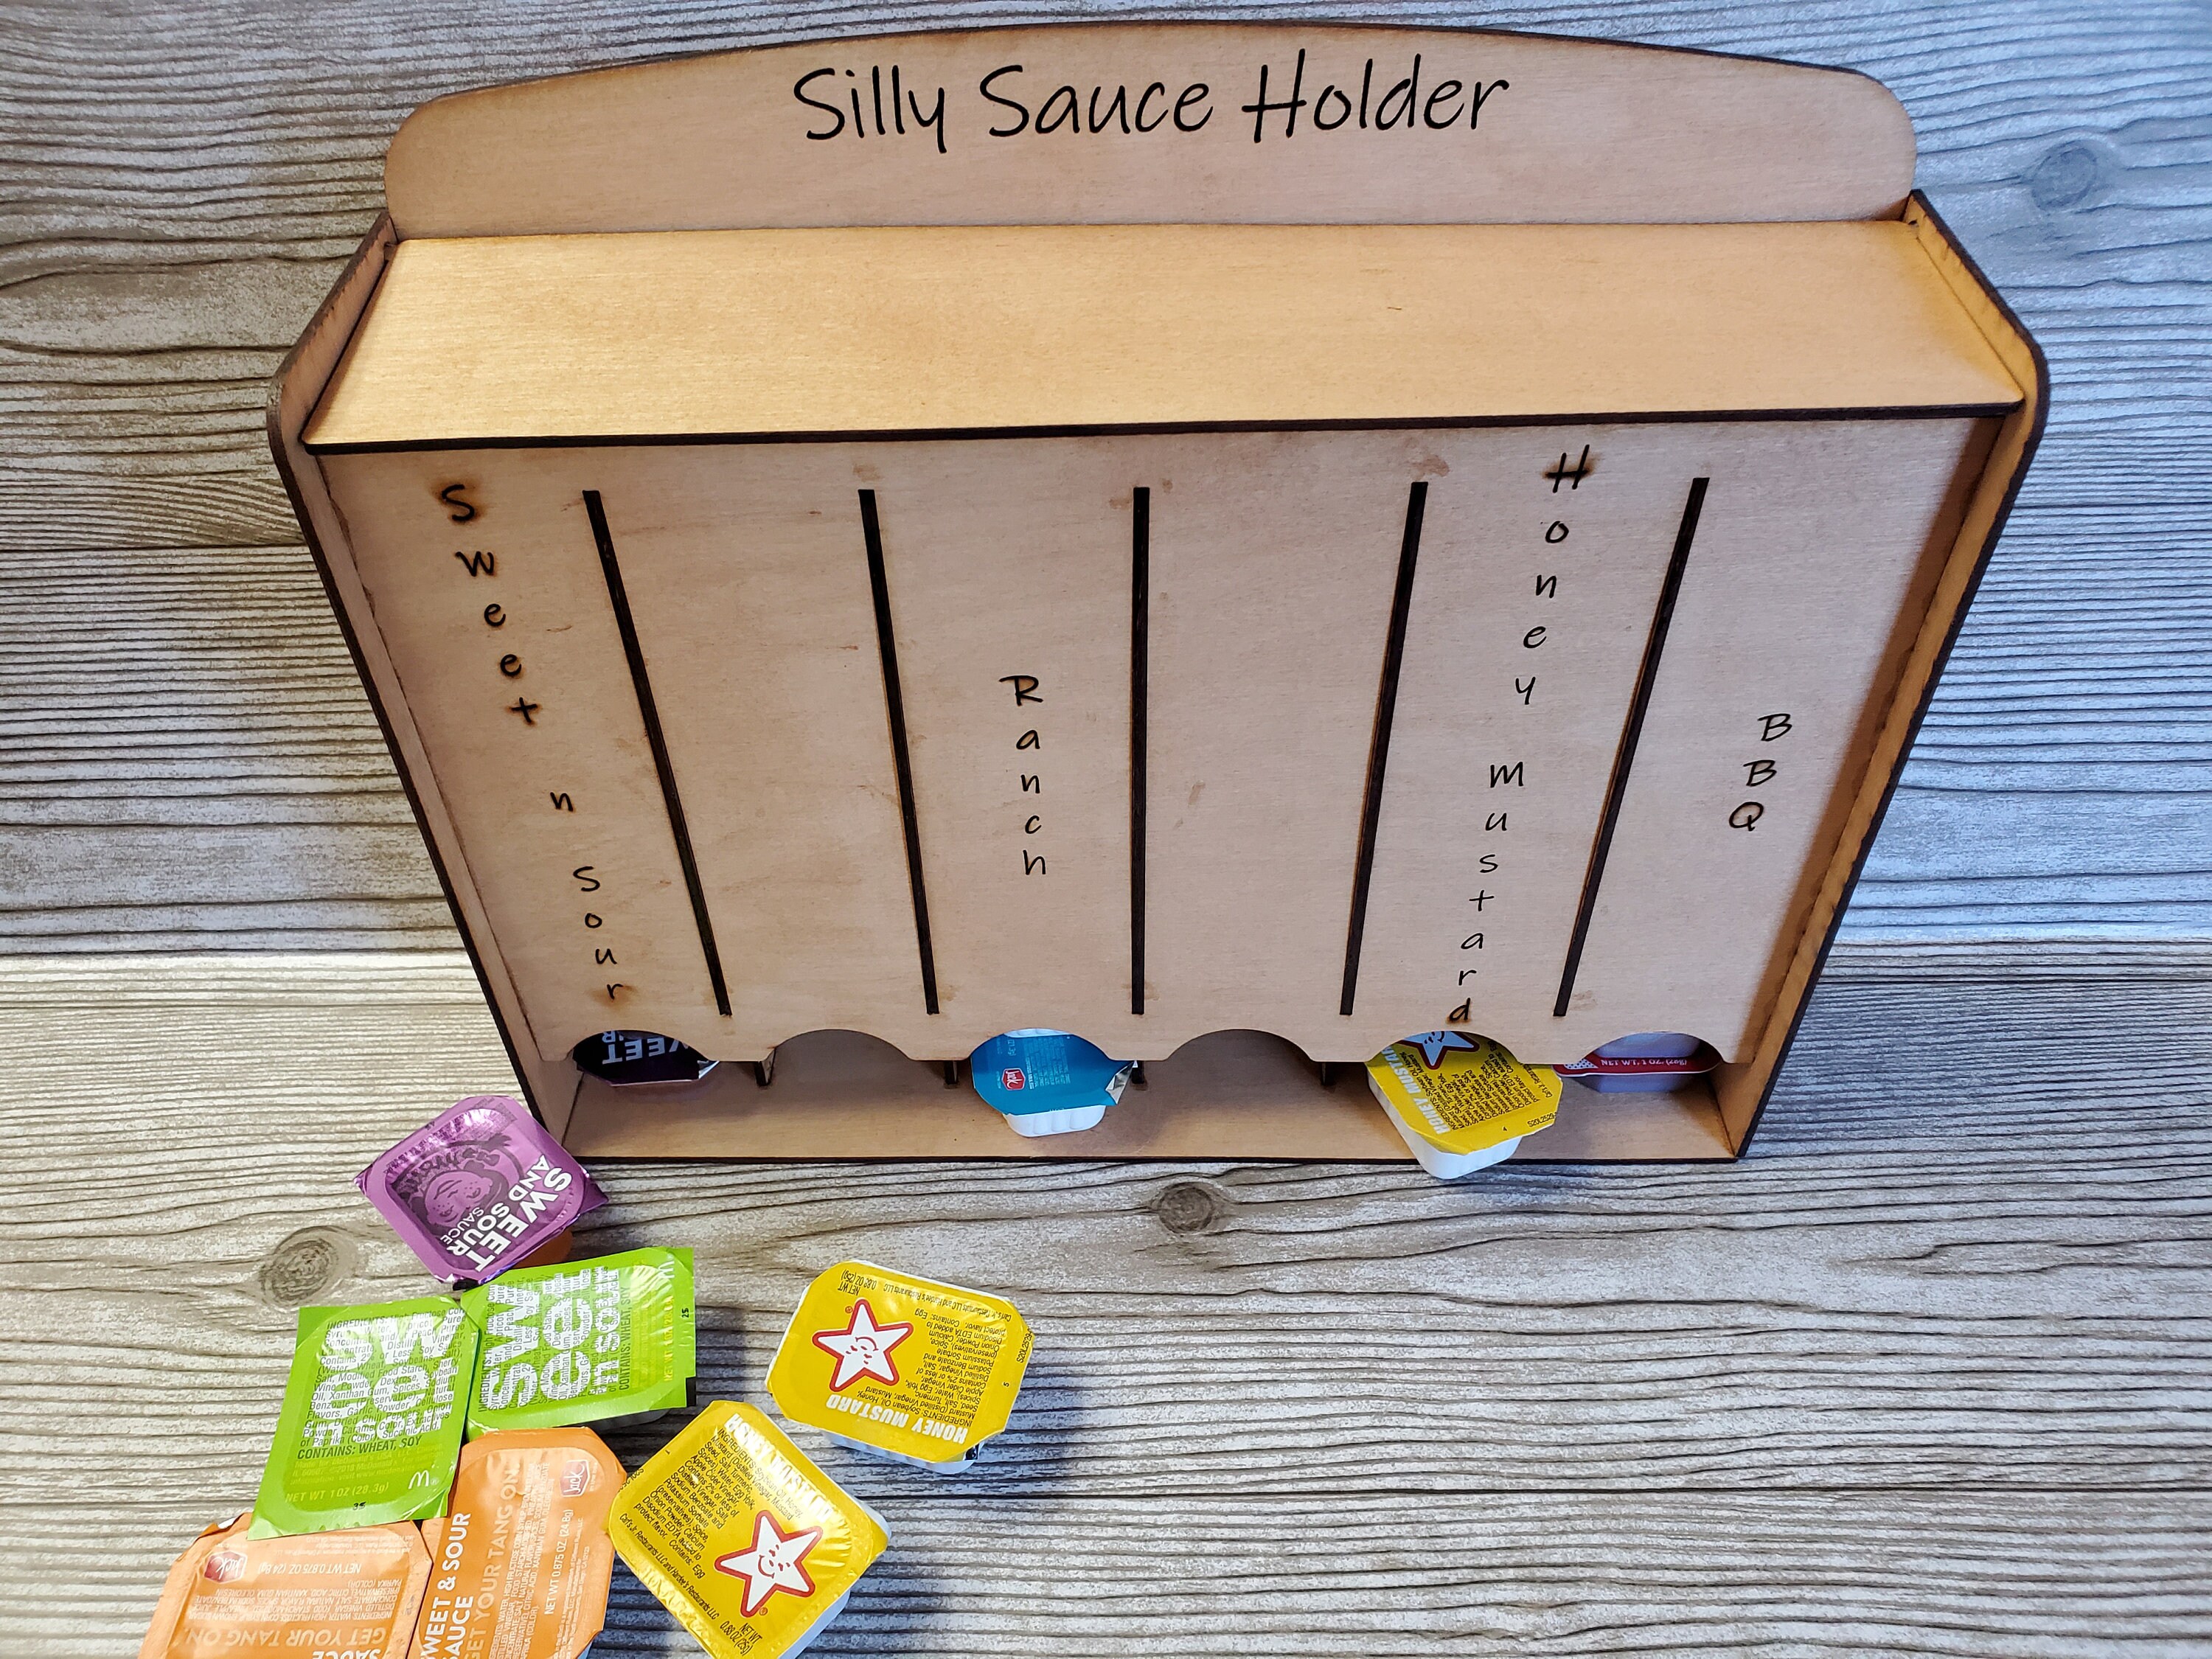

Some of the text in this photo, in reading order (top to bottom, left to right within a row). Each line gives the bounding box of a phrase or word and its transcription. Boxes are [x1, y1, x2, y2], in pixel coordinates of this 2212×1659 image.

[793, 49, 1509, 153] Silly Sauce Holder
[1515, 445, 1590, 704] Honey
[442, 484, 538, 724] Sweet
[551, 791, 574, 812] n
[574, 866, 623, 1000] Sour
[999, 675, 1046, 875] Ranch
[1728, 713, 1792, 831] BBQ
[1411, 1093, 1451, 1136] HONEY
[446, 1155, 549, 1259] AND SOUR
[466, 1167, 572, 1273] SWEET
[440, 1207, 484, 1246] SAUCE
[836, 1280, 861, 1295] NET WT
[840, 1269, 878, 1290] 0.88 OZ (25g)
[881, 1282, 894, 1294] LLC
[588, 1262, 624, 1354] sour
[941, 1298, 953, 1309] and
[950, 1301, 963, 1311] LLC
[913, 1307, 1006, 1338] protect flavor. Contains: Egg
[925, 1321, 1003, 1346] Disodium EDTA added to
[617, 1284, 633, 1391] CONTAINS: WHEAT, SOY
[928, 1329, 1001, 1353] Onion Powder, Calcium
[928, 1336, 998, 1360] (preservatives), Spice,
[664, 1349, 673, 1363] WT
[922, 1352, 992, 1375] Sodium Benzoate and
[935, 1347, 995, 1367] Potassium Sorbate
[663, 1364, 673, 1381] NET
[914, 1367, 924, 1376] of
[920, 1360, 990, 1383] Distilled Vinegar, Salt,
[923, 1369, 938, 1379] less
[945, 1374, 958, 1383] 2%
[958, 1375, 987, 1391] Contains
[902, 1379, 981, 1405] Spices), Water, Egg Yolk,
[919, 1374, 984, 1397] Apple Cider Vinegar,
[855, 1389, 973, 1428] INGREDIENTS: Soybean Oil, Honey,
[864, 1385, 975, 1421] Mustard (Distilled Vinegar, Mustard
[912, 1389, 978, 1413] Seed, Salt, Turmeric,
[350, 1403, 453, 1444] sour
[824, 1392, 969, 1444] HONEY MUSTARD
[296, 1435, 422, 1461] CONTAINS: WHEAT, SOY
[715, 1427, 759, 1471] INGREDIENTS:
[564, 1462, 585, 1492] Jack
[694, 1447, 757, 1511] Spices), Water, Egg Yolk,
[702, 1440, 755, 1495] Seed, Salt, Turmeric,
[284, 1491, 307, 1504] NET
[307, 1489, 326, 1501] WT
[335, 1486, 350, 1498] OZ
[350, 1481, 389, 1497] (28.3g)
[561, 1509, 574, 1537] (24.8g)
[632, 1501, 707, 1579] protect flavor. Contains: Egg
[327, 1563, 346, 1574] WT
[347, 1563, 361, 1574] NET
[476, 1562, 502, 1621] YOUR
[489, 1503, 516, 1562] TANG
[553, 1552, 564, 1579] 0.875
[420, 1513, 471, 1659] WEET & SOUR
[549, 1579, 560, 1596] WT
[544, 1596, 556, 1615] NET
[231, 1627, 284, 1646] TANG
[287, 1627, 341, 1646] YOUR
[348, 1627, 387, 1646] GET
[442, 1596, 474, 1659] AUCE
[718, 1619, 754, 1656] 0.88 OZ (25g)
[738, 1621, 762, 1646] NET WT
